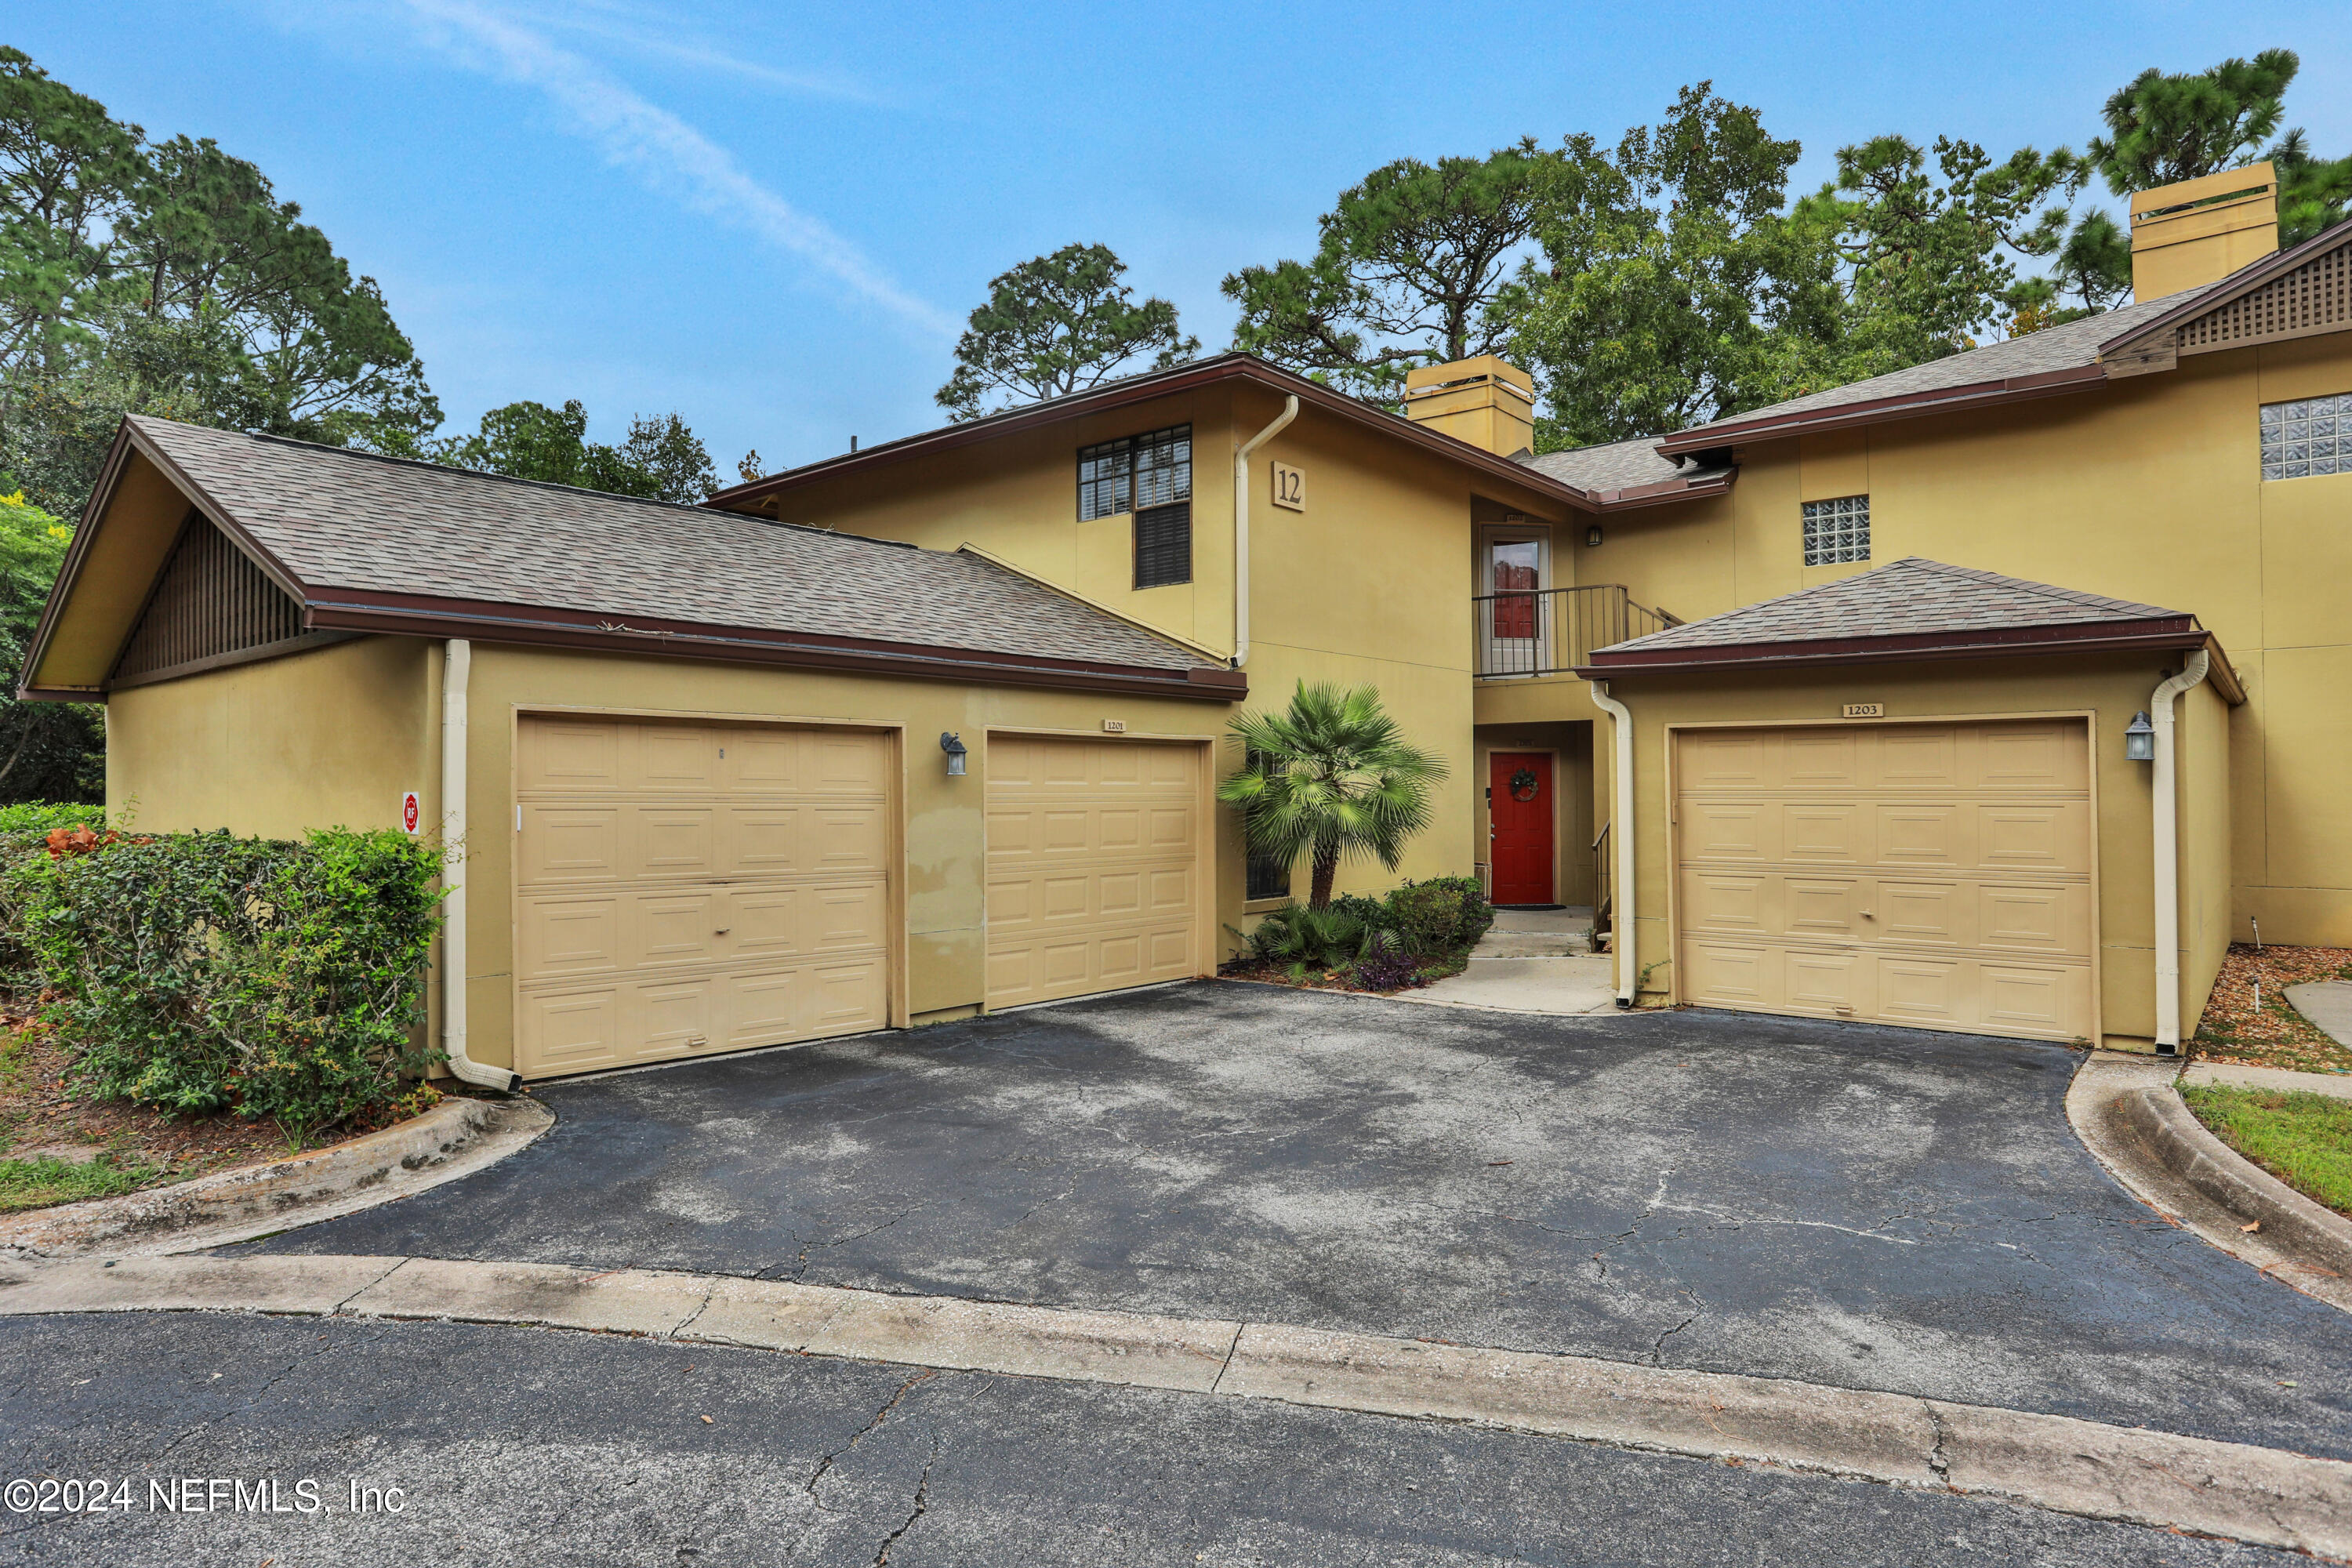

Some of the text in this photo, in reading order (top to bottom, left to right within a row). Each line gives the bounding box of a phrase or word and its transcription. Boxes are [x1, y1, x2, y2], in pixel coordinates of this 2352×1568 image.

[1279, 469, 1301, 504] 12
[1848, 706, 1878, 715] 1203
[1108, 721, 1123, 730] 1201
[407, 807, 415, 819] RF
